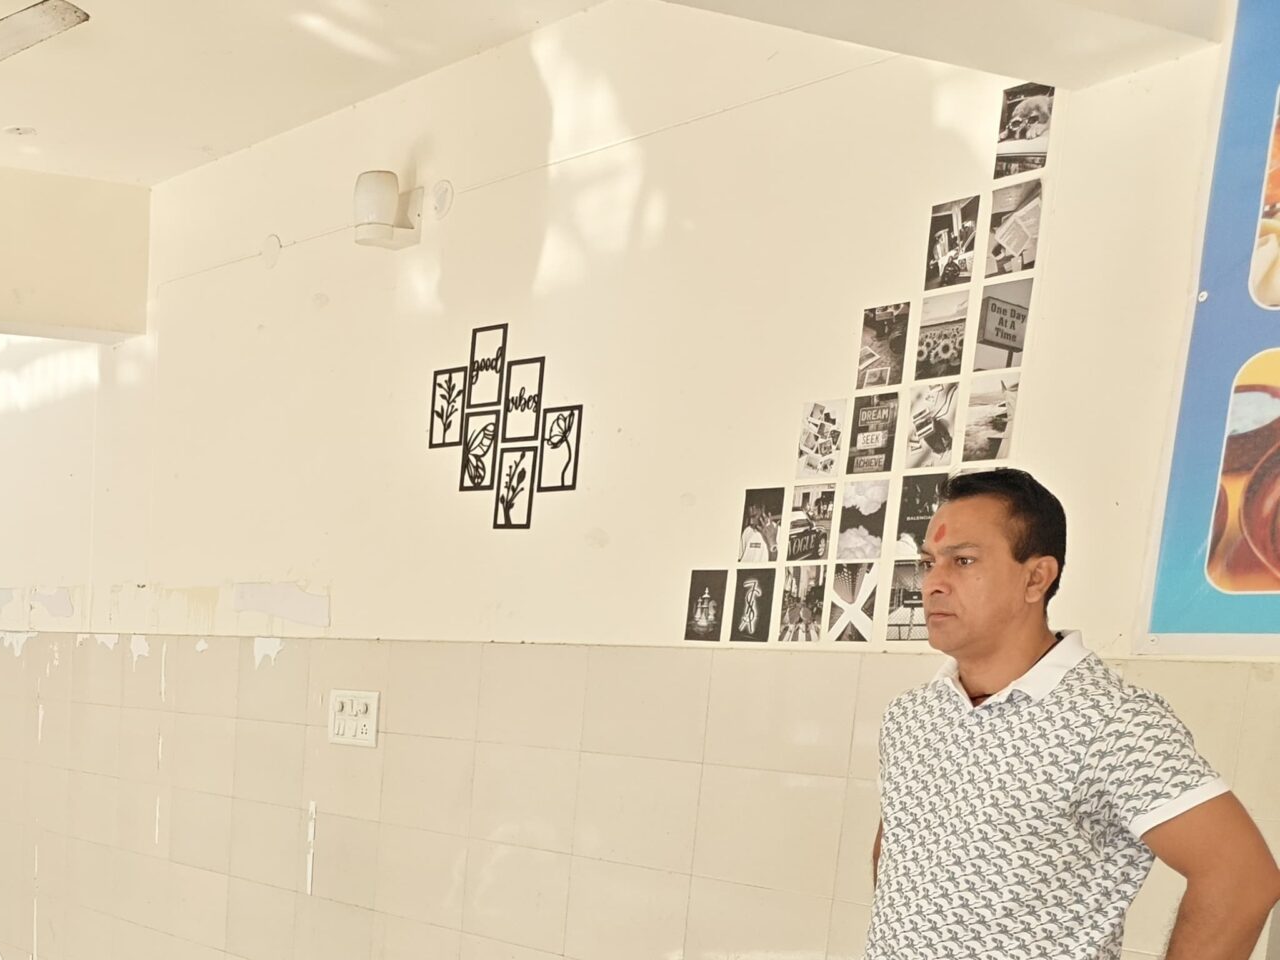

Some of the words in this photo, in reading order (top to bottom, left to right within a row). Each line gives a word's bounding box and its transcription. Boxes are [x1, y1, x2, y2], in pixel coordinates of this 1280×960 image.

[991, 303, 1007, 316] One
[1010, 309, 1026, 323] Day
[998, 317, 1008, 328] At
[1010, 320, 1015, 330] A
[995, 327, 1017, 342] Time
[471, 346, 503, 385] good
[507, 387, 539, 413] vibes
[861, 408, 889, 421] DREAM
[861, 434, 880, 445] SEEK
[855, 457, 883, 468] ACHIEVE
